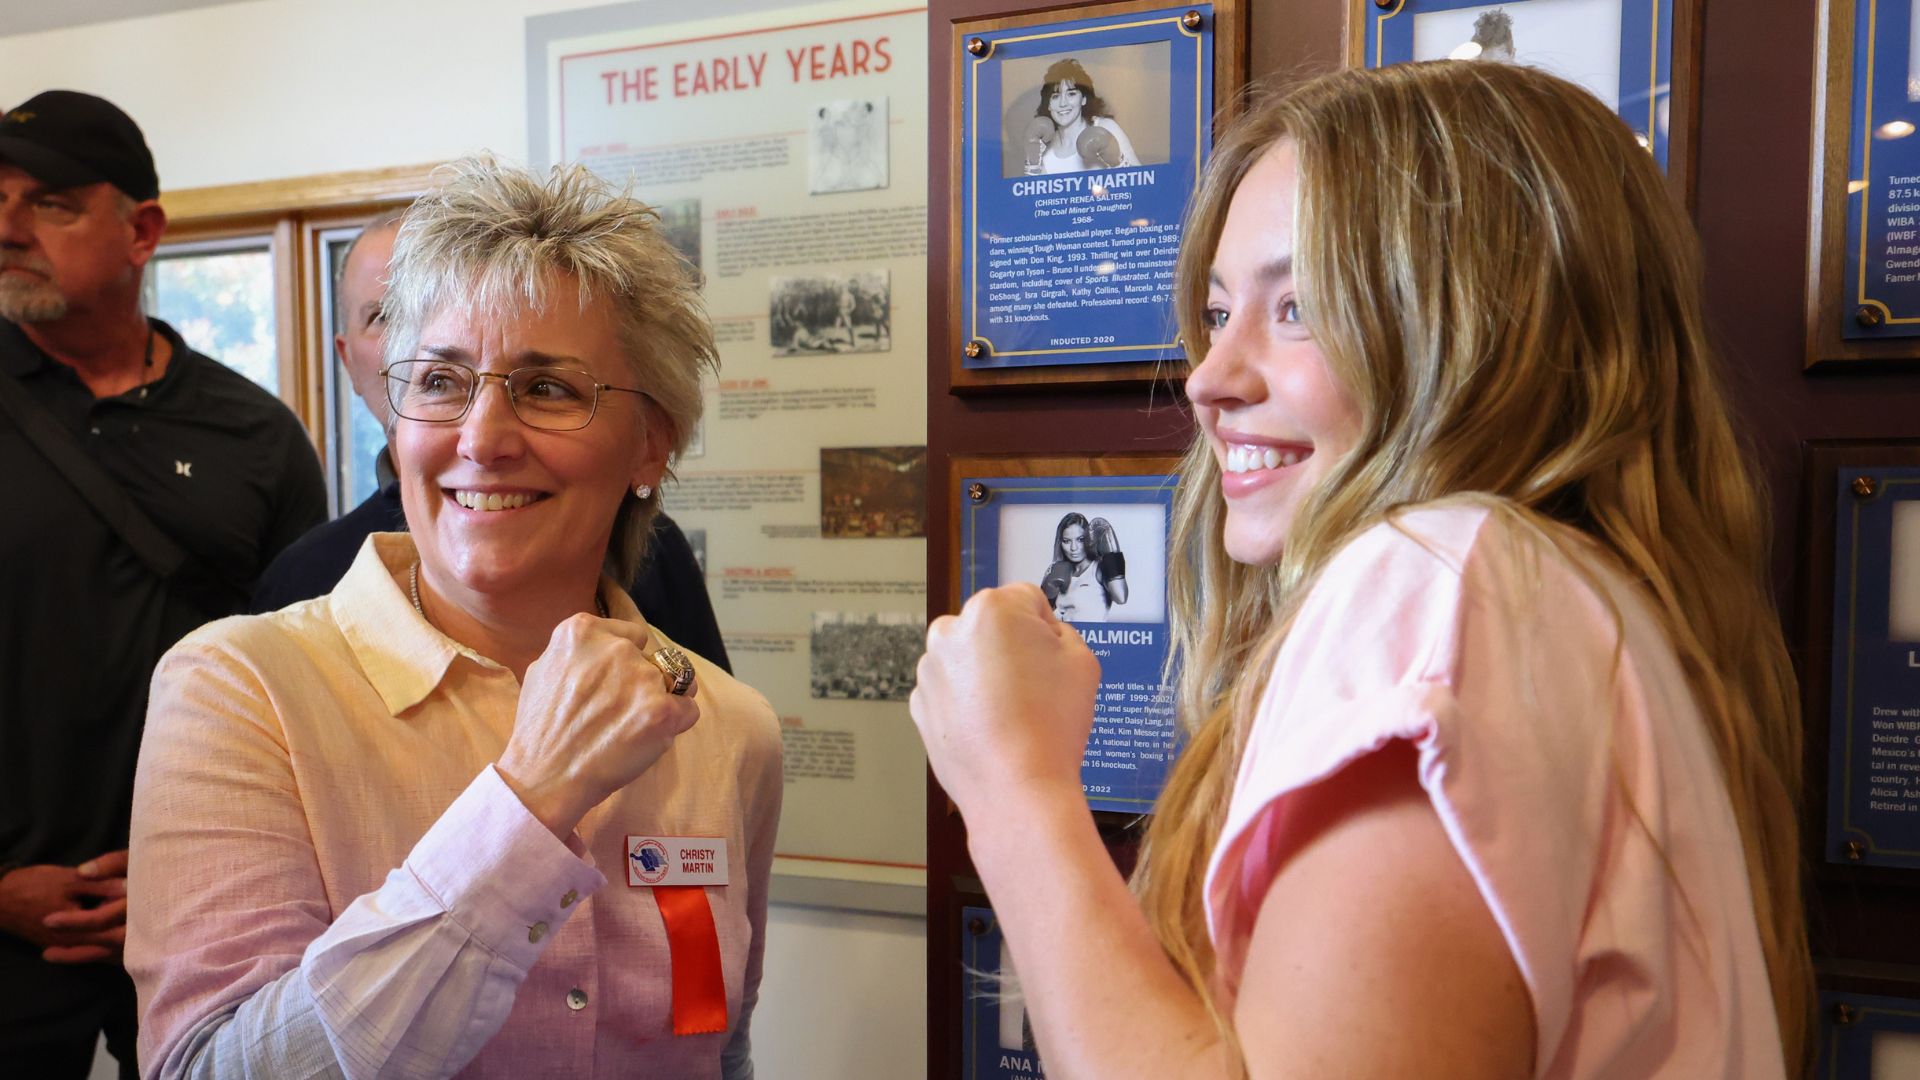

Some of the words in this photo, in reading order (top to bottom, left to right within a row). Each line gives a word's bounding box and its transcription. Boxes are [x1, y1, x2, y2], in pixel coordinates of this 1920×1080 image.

[600, 66, 659, 105] THE
[674, 52, 767, 97] EARLY
[786, 37, 892, 83] YEARS
[1012, 177, 1083, 196] CHRISTY
[1088, 170, 1155, 190] MARTIN
[1889, 189, 1912, 199] 87.5
[1035, 198, 1068, 207] (CHRISTY
[1070, 195, 1094, 204] RENEA
[1096, 193, 1132, 202] SALTERS)
[1034, 210, 1050, 218] (The
[1052, 208, 1067, 216] Coal
[1069, 206, 1095, 215] Miner's
[1097, 203, 1132, 213] Daughter)
[1072, 216, 1094, 224] 1968-
[1888, 217, 1915, 226] WIBA
[990, 236, 1013, 244] Former
[1014, 234, 1052, 242] scholarship
[1054, 230, 1090, 239] basketball
[1091, 229, 1113, 237] player.
[1115, 227, 1137, 235] Began
[1140, 225, 1163, 233] boxing
[1887, 230, 1917, 242] (IWBF
[990, 248, 1006, 256] dare,
[1008, 246, 1033, 255] winning
[1034, 244, 1054, 253] Tough
[1056, 243, 1081, 251] Woman
[1083, 240, 1110, 248] contest.
[1112, 238, 1135, 246] Turned
[1136, 238, 1148, 246] pro
[990, 259, 1011, 268] signed
[1068, 253, 1088, 261] 1993.
[1091, 251, 1118, 260] Thrilling
[1121, 250, 1132, 258] win
[1154, 247, 1180, 256] Deirdre
[990, 270, 1015, 279] Gogarty
[1026, 268, 1045, 277] Tyson
[1052, 266, 1072, 274] Bruno
[1116, 262, 1127, 270] led
[1022, 279, 1052, 288] including
[1055, 278, 1074, 286] cover
[1085, 276, 1108, 284] Sports
[1112, 272, 1151, 282] Illustrated.
[1025, 291, 1038, 299] Isra
[1072, 288, 1091, 296] Kathy
[1095, 286, 1120, 295] Collins,
[1125, 284, 1153, 293] Marcela
[990, 305, 1012, 313] among
[1014, 304, 1031, 312] many
[1033, 302, 1045, 310] she
[1047, 301, 1079, 309] defeated.
[1081, 297, 1123, 307] Professional
[1125, 296, 1149, 304] record:
[990, 316, 1003, 324] with
[1015, 314, 1050, 322] knockouts.
[1050, 338, 1091, 346] INDUCTED
[1094, 336, 1115, 344] 2020
[1105, 694, 1126, 702] (WIBF
[1123, 706, 1142, 714] super
[1873, 706, 1898, 716] Drew
[1125, 717, 1144, 726] Daisy
[1872, 721, 1895, 729] Won
[1134, 729, 1159, 737] Messer
[1134, 740, 1150, 748] hero
[1872, 734, 1909, 744] Deirdre
[1140, 752, 1164, 761] boxing
[1872, 748, 1916, 758] Mexico's
[1092, 760, 1100, 768] 16
[1101, 761, 1138, 770] knockouts.
[1872, 761, 1885, 770] tal
[1888, 762, 1897, 770] in
[1870, 788, 1898, 797] Alicia
[1870, 801, 1906, 811] Retired
[1908, 804, 1918, 812] in
[680, 849, 715, 860] CHRISTY
[683, 862, 714, 873] MARTIN
[1000, 1055, 1032, 1072] ANA
